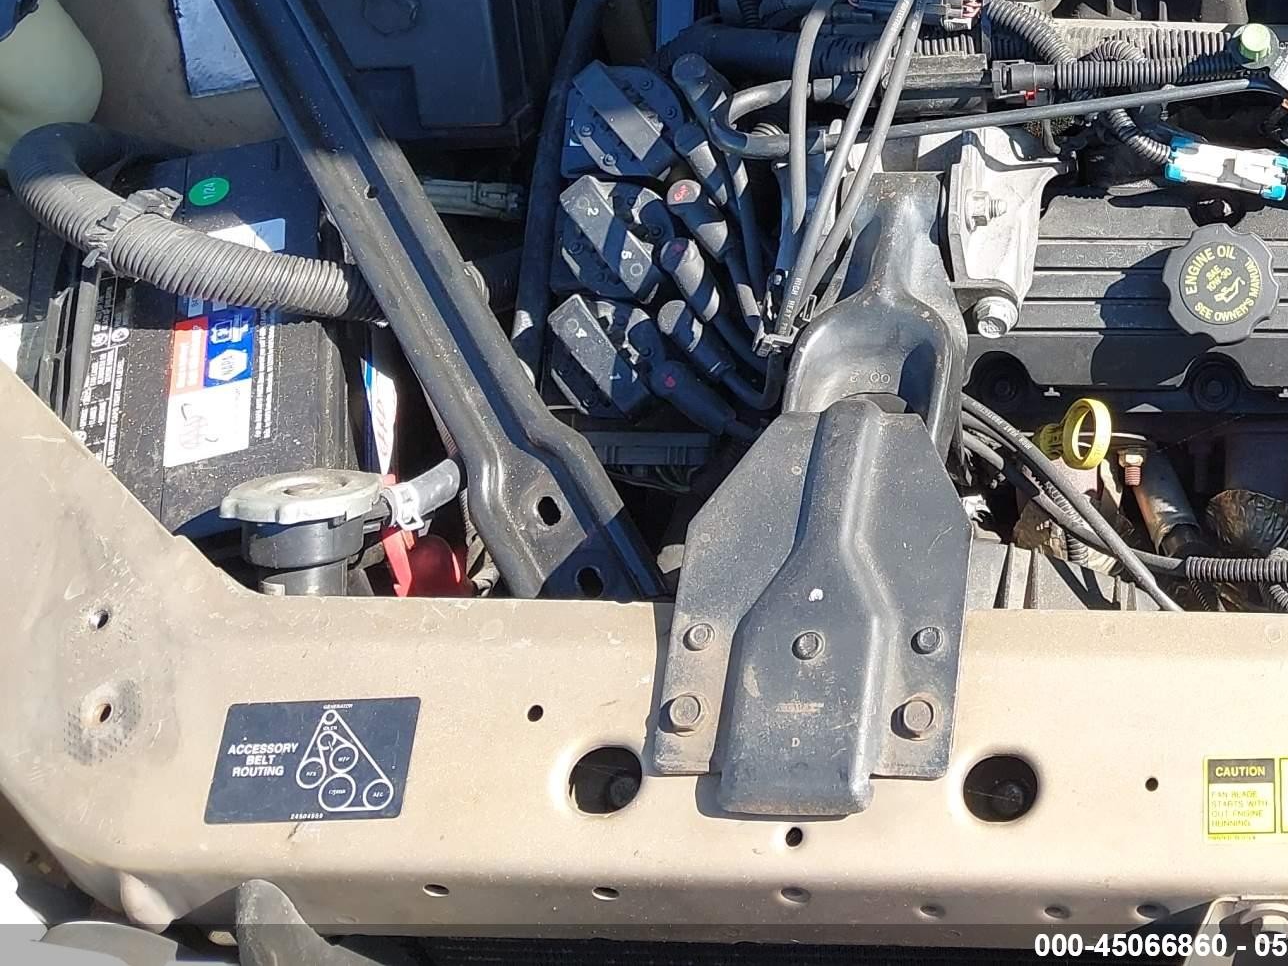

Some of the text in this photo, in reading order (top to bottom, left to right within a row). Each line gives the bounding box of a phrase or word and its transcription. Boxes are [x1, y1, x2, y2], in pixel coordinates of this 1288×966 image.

[1184, 245, 1236, 296] ENGINE OIL
[1206, 268, 1232, 292] 10W-30
[1194, 256, 1261, 322] SEE OWNER'S MANUAL
[786, 278, 802, 321] HIGH HEAT
[228, 742, 299, 755] ACCESSORY
[792, 738, 800, 748] D
[246, 754, 275, 766] BELT
[232, 765, 285, 778] ROUTING
[1215, 766, 1266, 777] CAUTION
